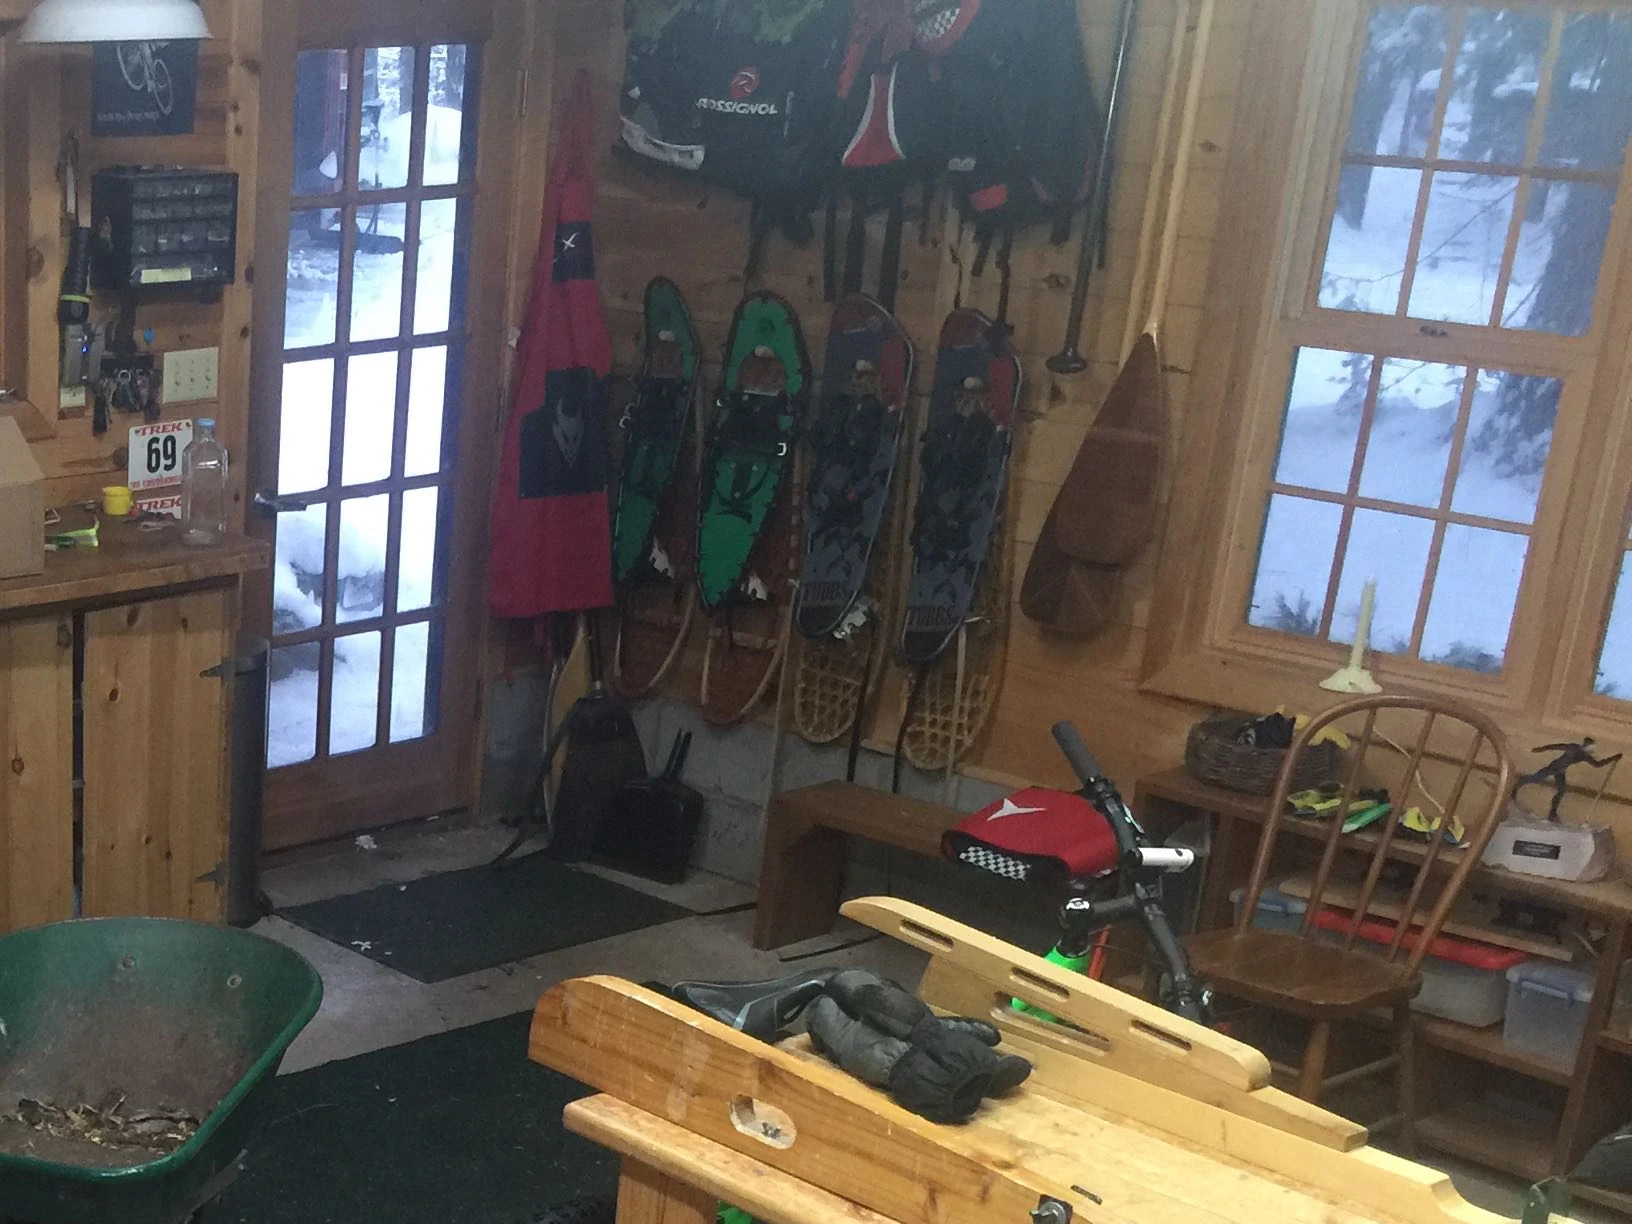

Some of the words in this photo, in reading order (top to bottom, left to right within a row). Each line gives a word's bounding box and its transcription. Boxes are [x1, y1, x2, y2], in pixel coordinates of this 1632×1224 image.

[696, 98, 778, 115] ROSSIGNOL
[138, 422, 182, 436] TREK
[147, 435, 177, 473] 69
[137, 497, 181, 511] TREK
